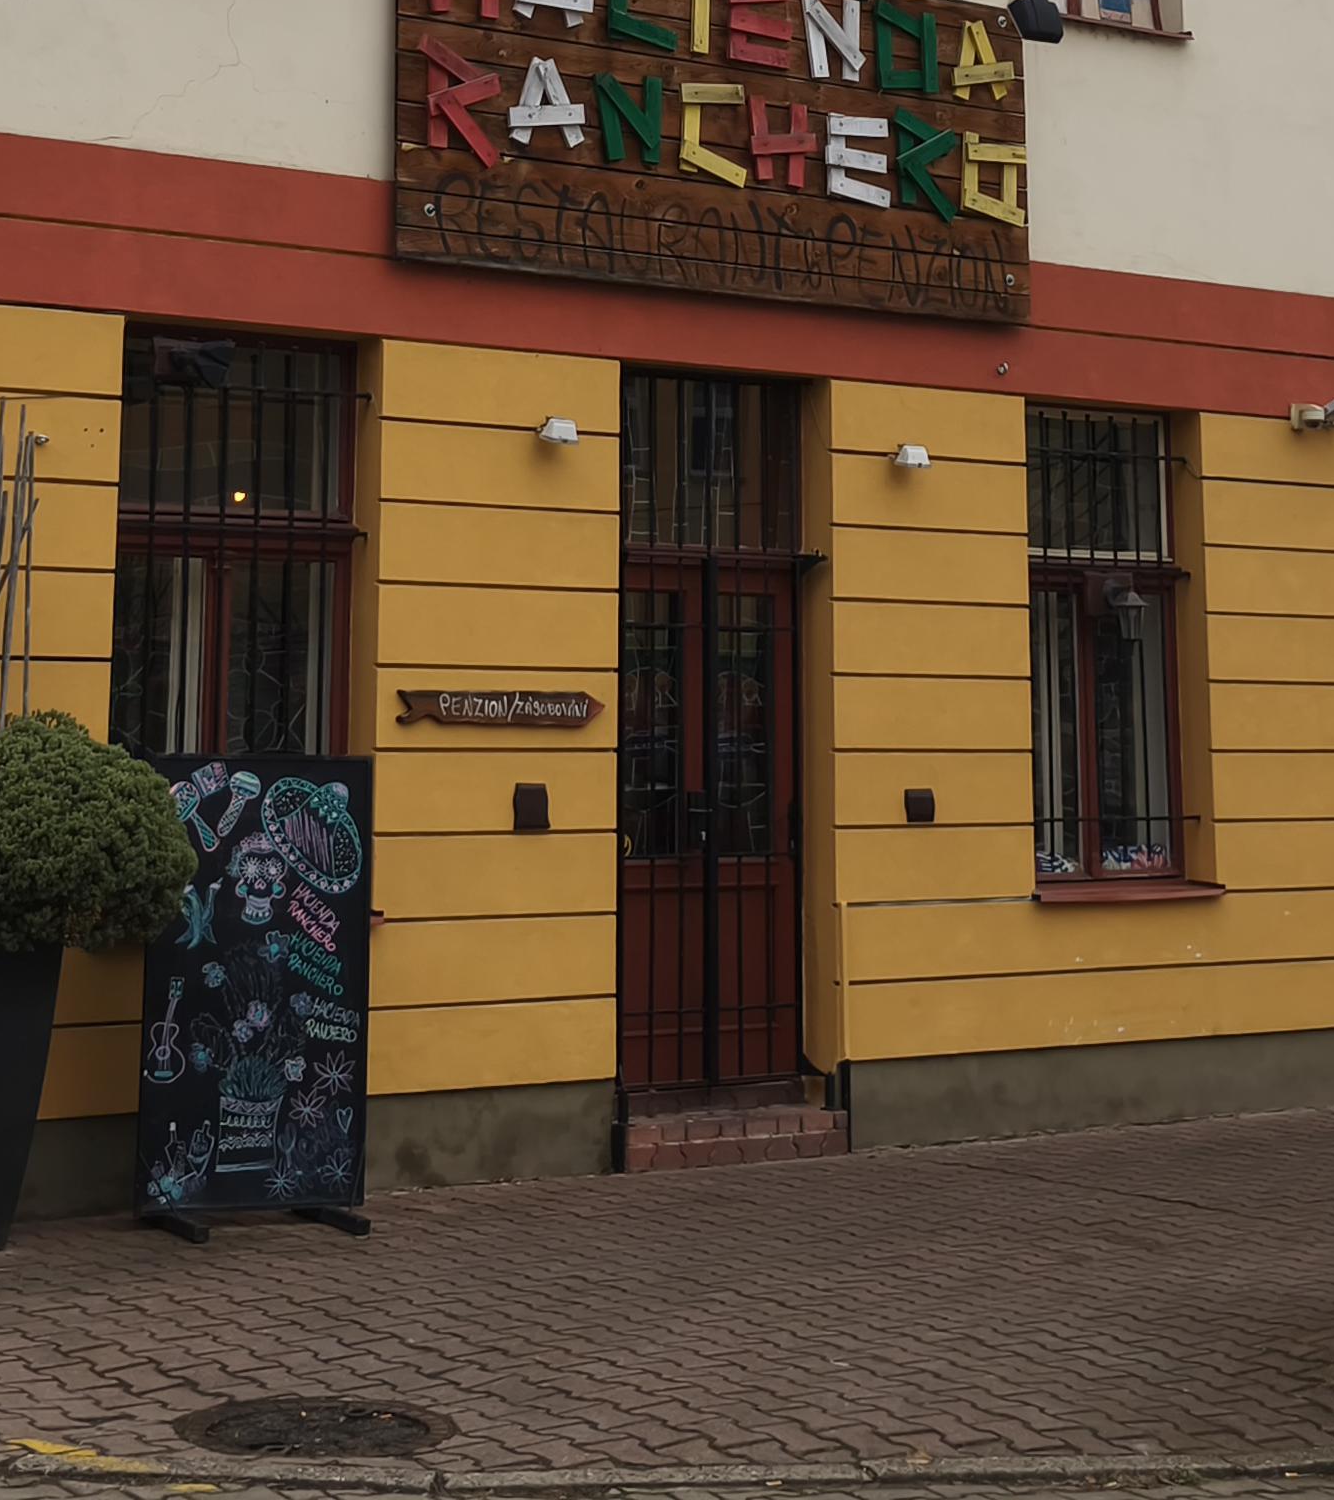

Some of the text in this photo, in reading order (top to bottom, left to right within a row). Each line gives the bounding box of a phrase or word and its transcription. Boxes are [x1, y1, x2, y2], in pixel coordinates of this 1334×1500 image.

[418, 33, 1027, 226] RANCHERO
[434, 172, 795, 292] RESTAURANT
[825, 213, 1008, 314] PENZION
[287, 900, 336, 952] RANCHERO
[291, 881, 340, 935] HACIENDA
[288, 953, 343, 995] RANCHERO
[290, 930, 342, 976] HACIENDA
[312, 997, 360, 1028] HACIENDA
